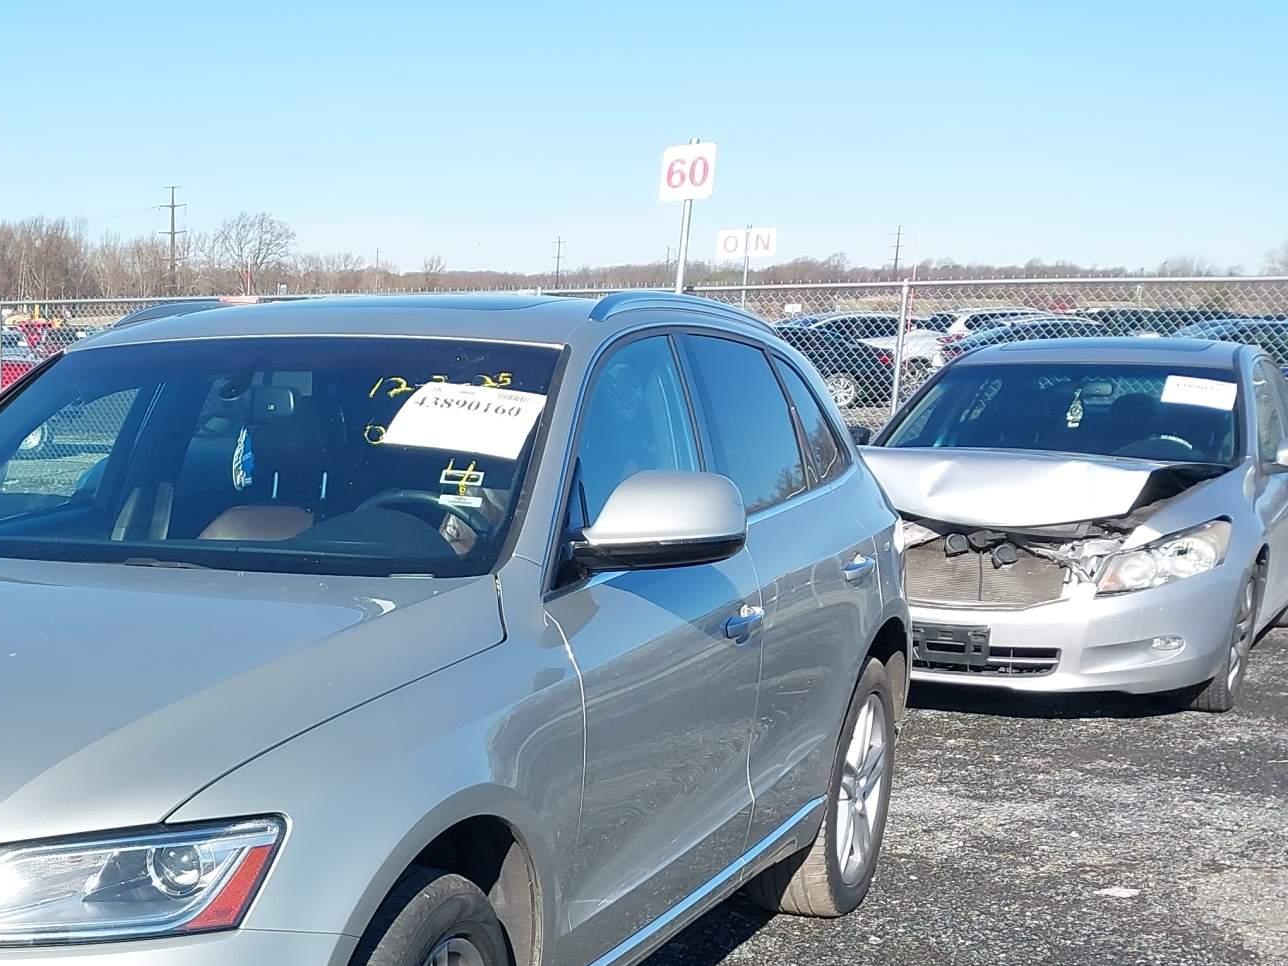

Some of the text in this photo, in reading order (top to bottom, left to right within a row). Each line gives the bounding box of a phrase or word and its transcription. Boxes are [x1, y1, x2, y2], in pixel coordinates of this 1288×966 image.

[666, 156, 709, 188] 60
[755, 233, 770, 251] N
[414, 396, 522, 417] 43890160
